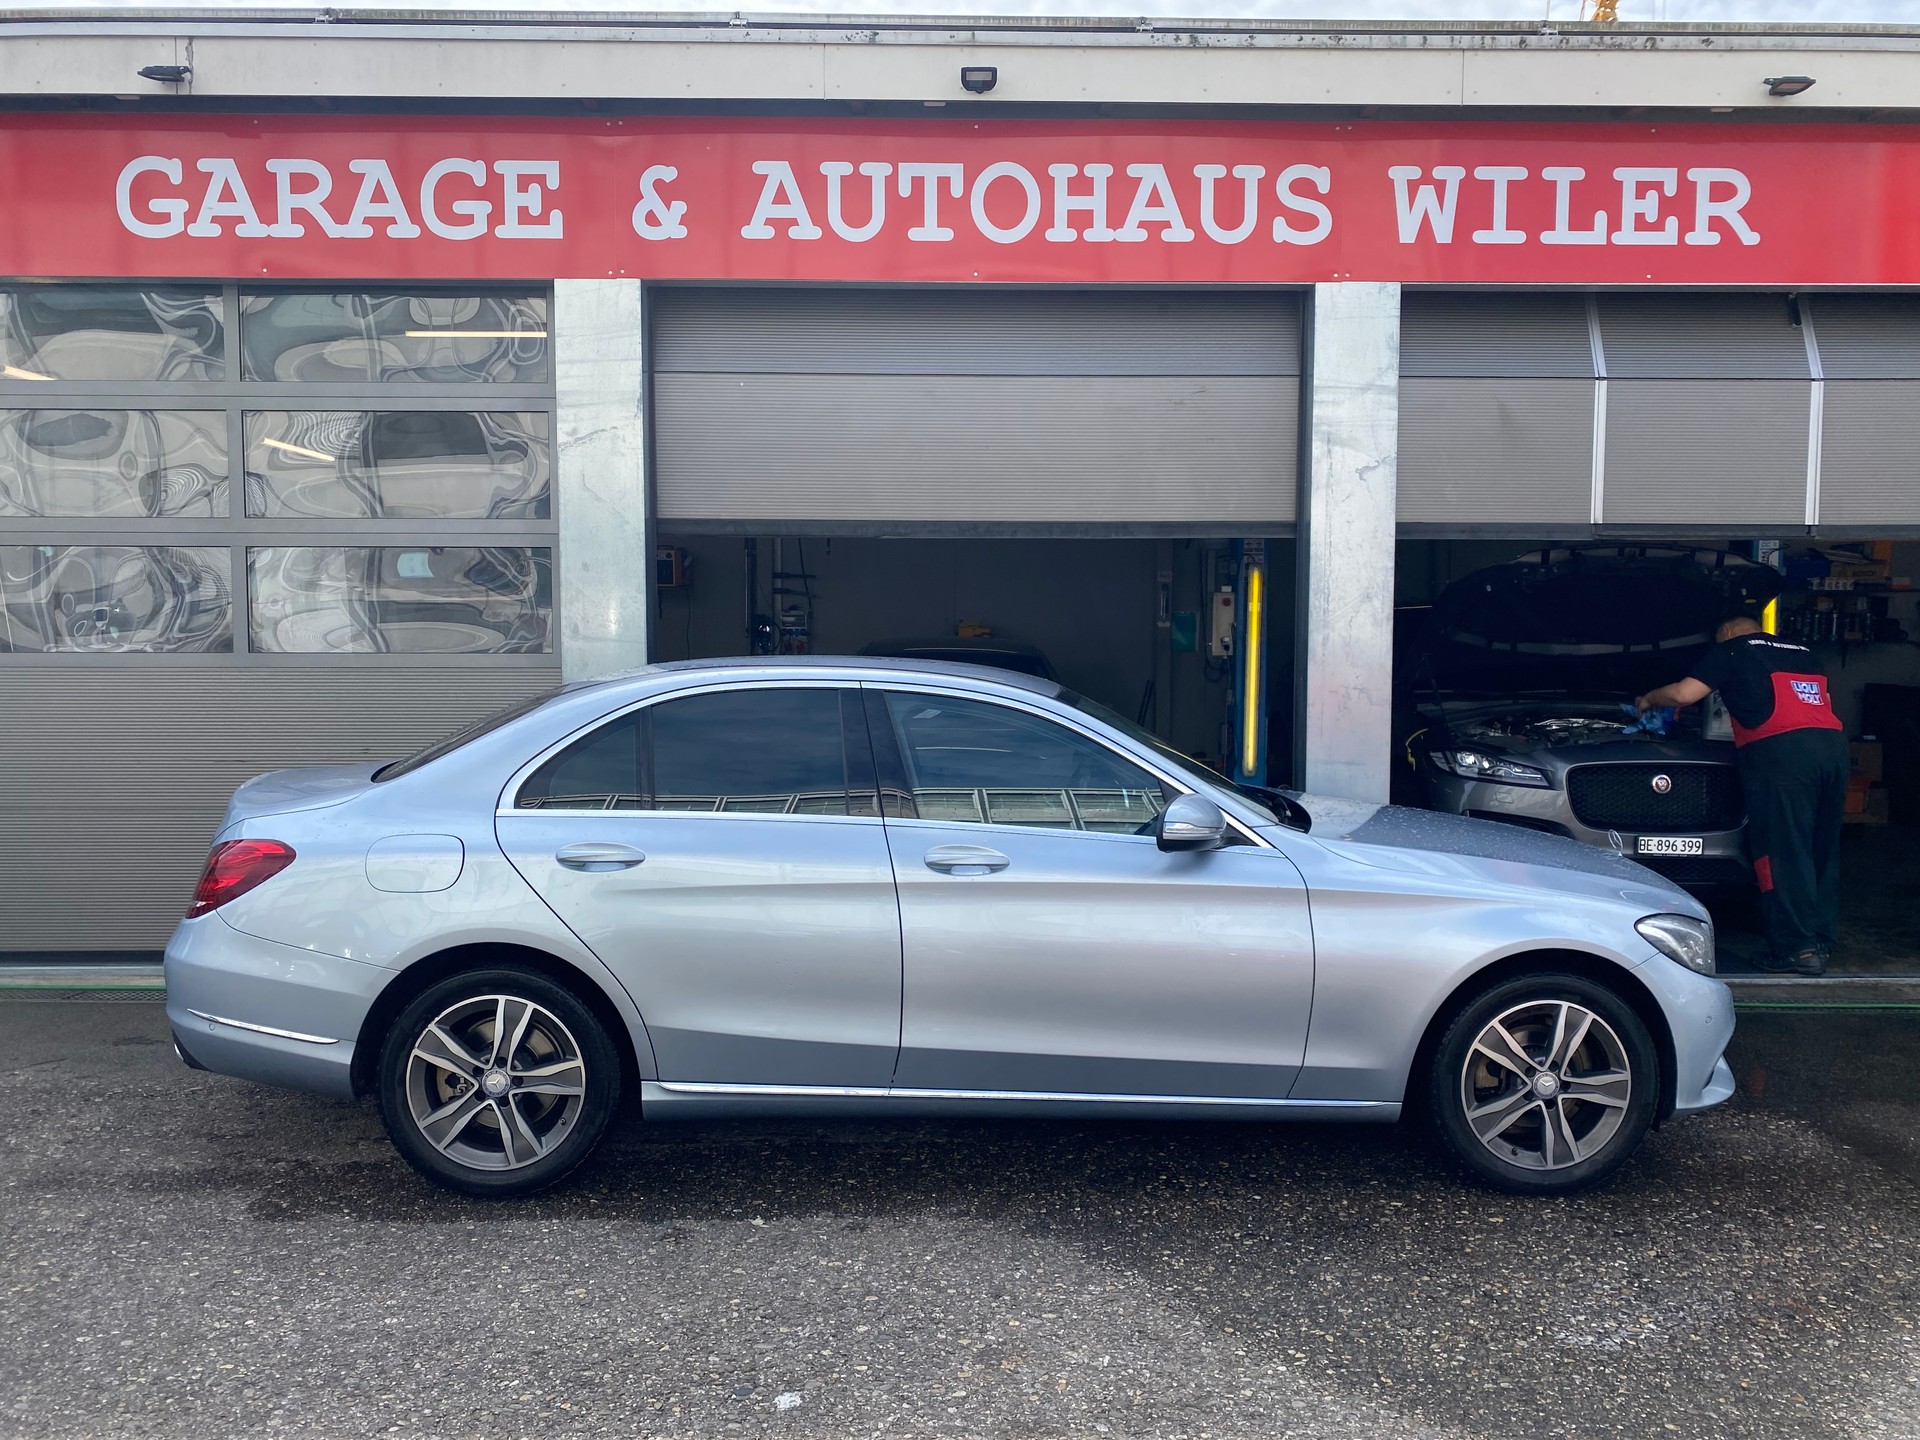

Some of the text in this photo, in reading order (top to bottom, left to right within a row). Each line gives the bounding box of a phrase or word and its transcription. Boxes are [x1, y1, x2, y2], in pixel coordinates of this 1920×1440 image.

[116, 156, 1760, 246] GARAGE & AUTOHAUS WILER
[1793, 682, 1819, 694] LIQUI
[1798, 692, 1821, 704] MOLY
